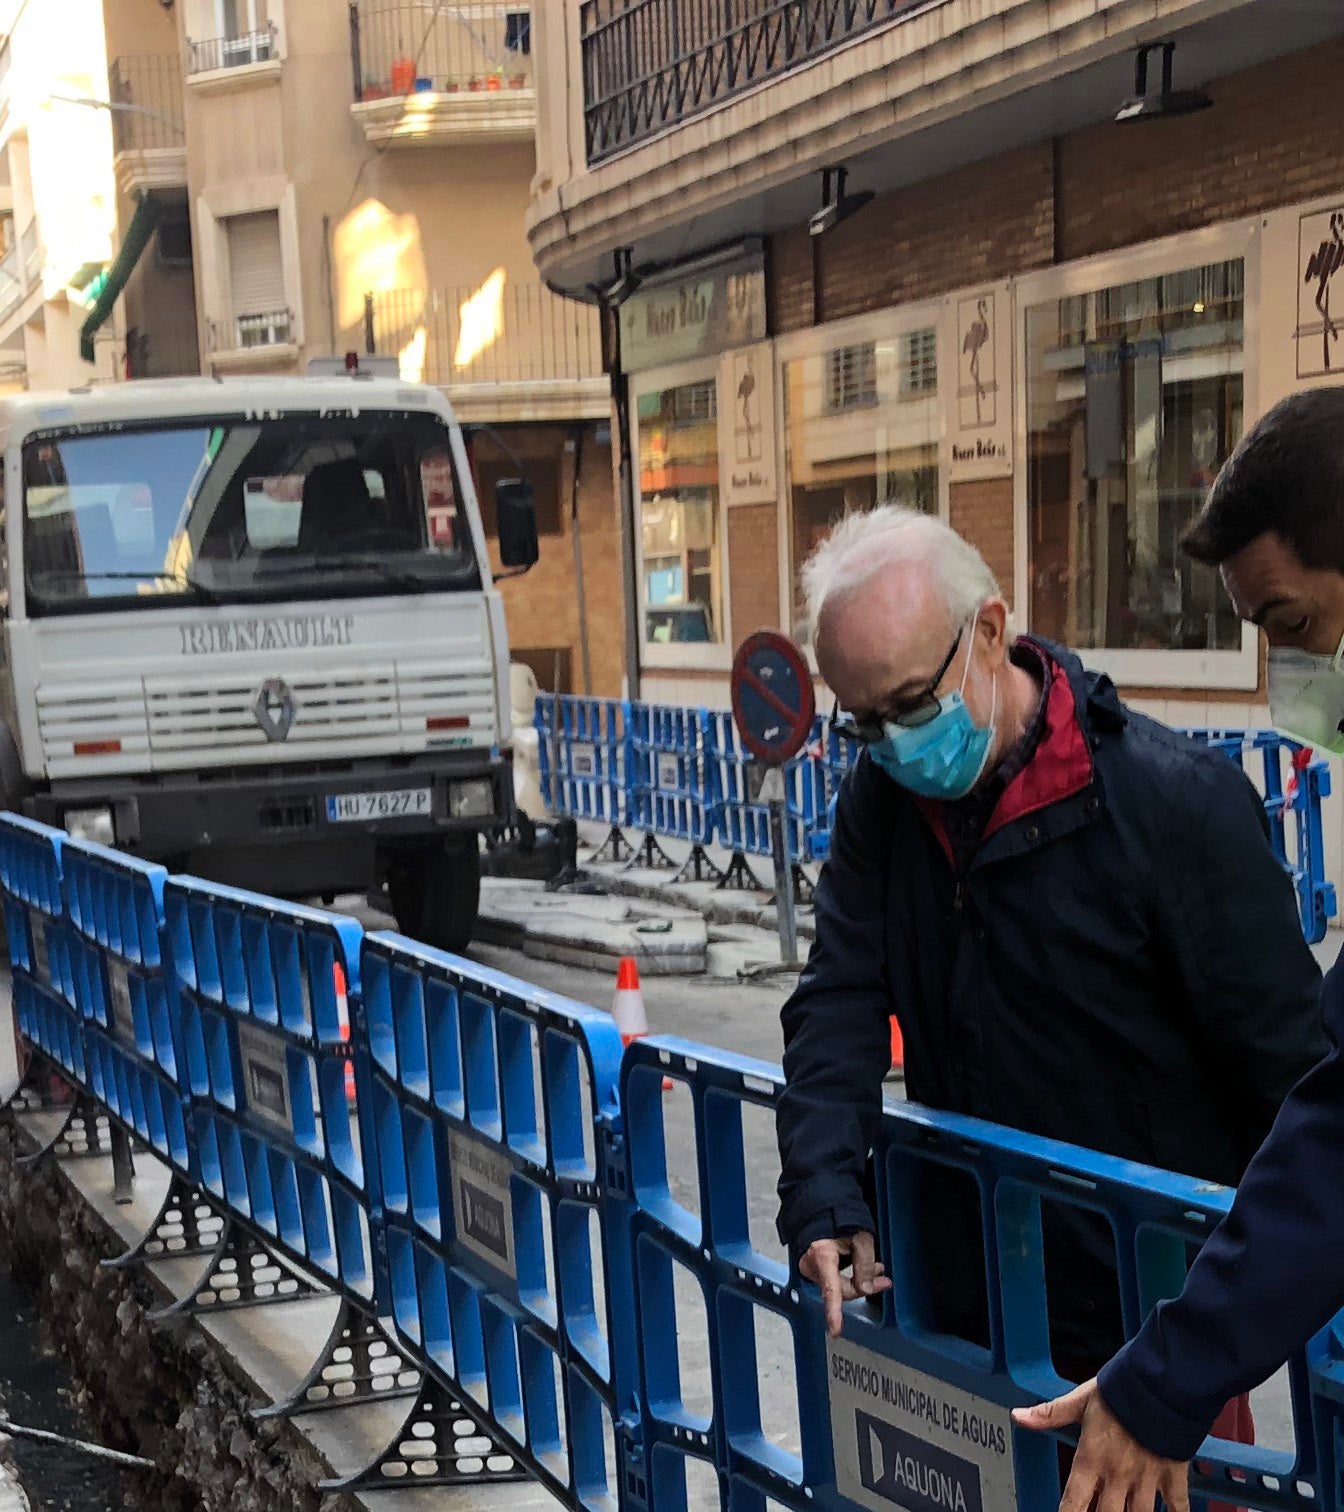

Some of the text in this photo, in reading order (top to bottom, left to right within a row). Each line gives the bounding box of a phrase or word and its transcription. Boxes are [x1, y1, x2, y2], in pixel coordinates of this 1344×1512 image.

[179, 614, 355, 656] RENAULT
[831, 1353, 1006, 1454] SERVICIO MUNICIPAL DE AGUAS
